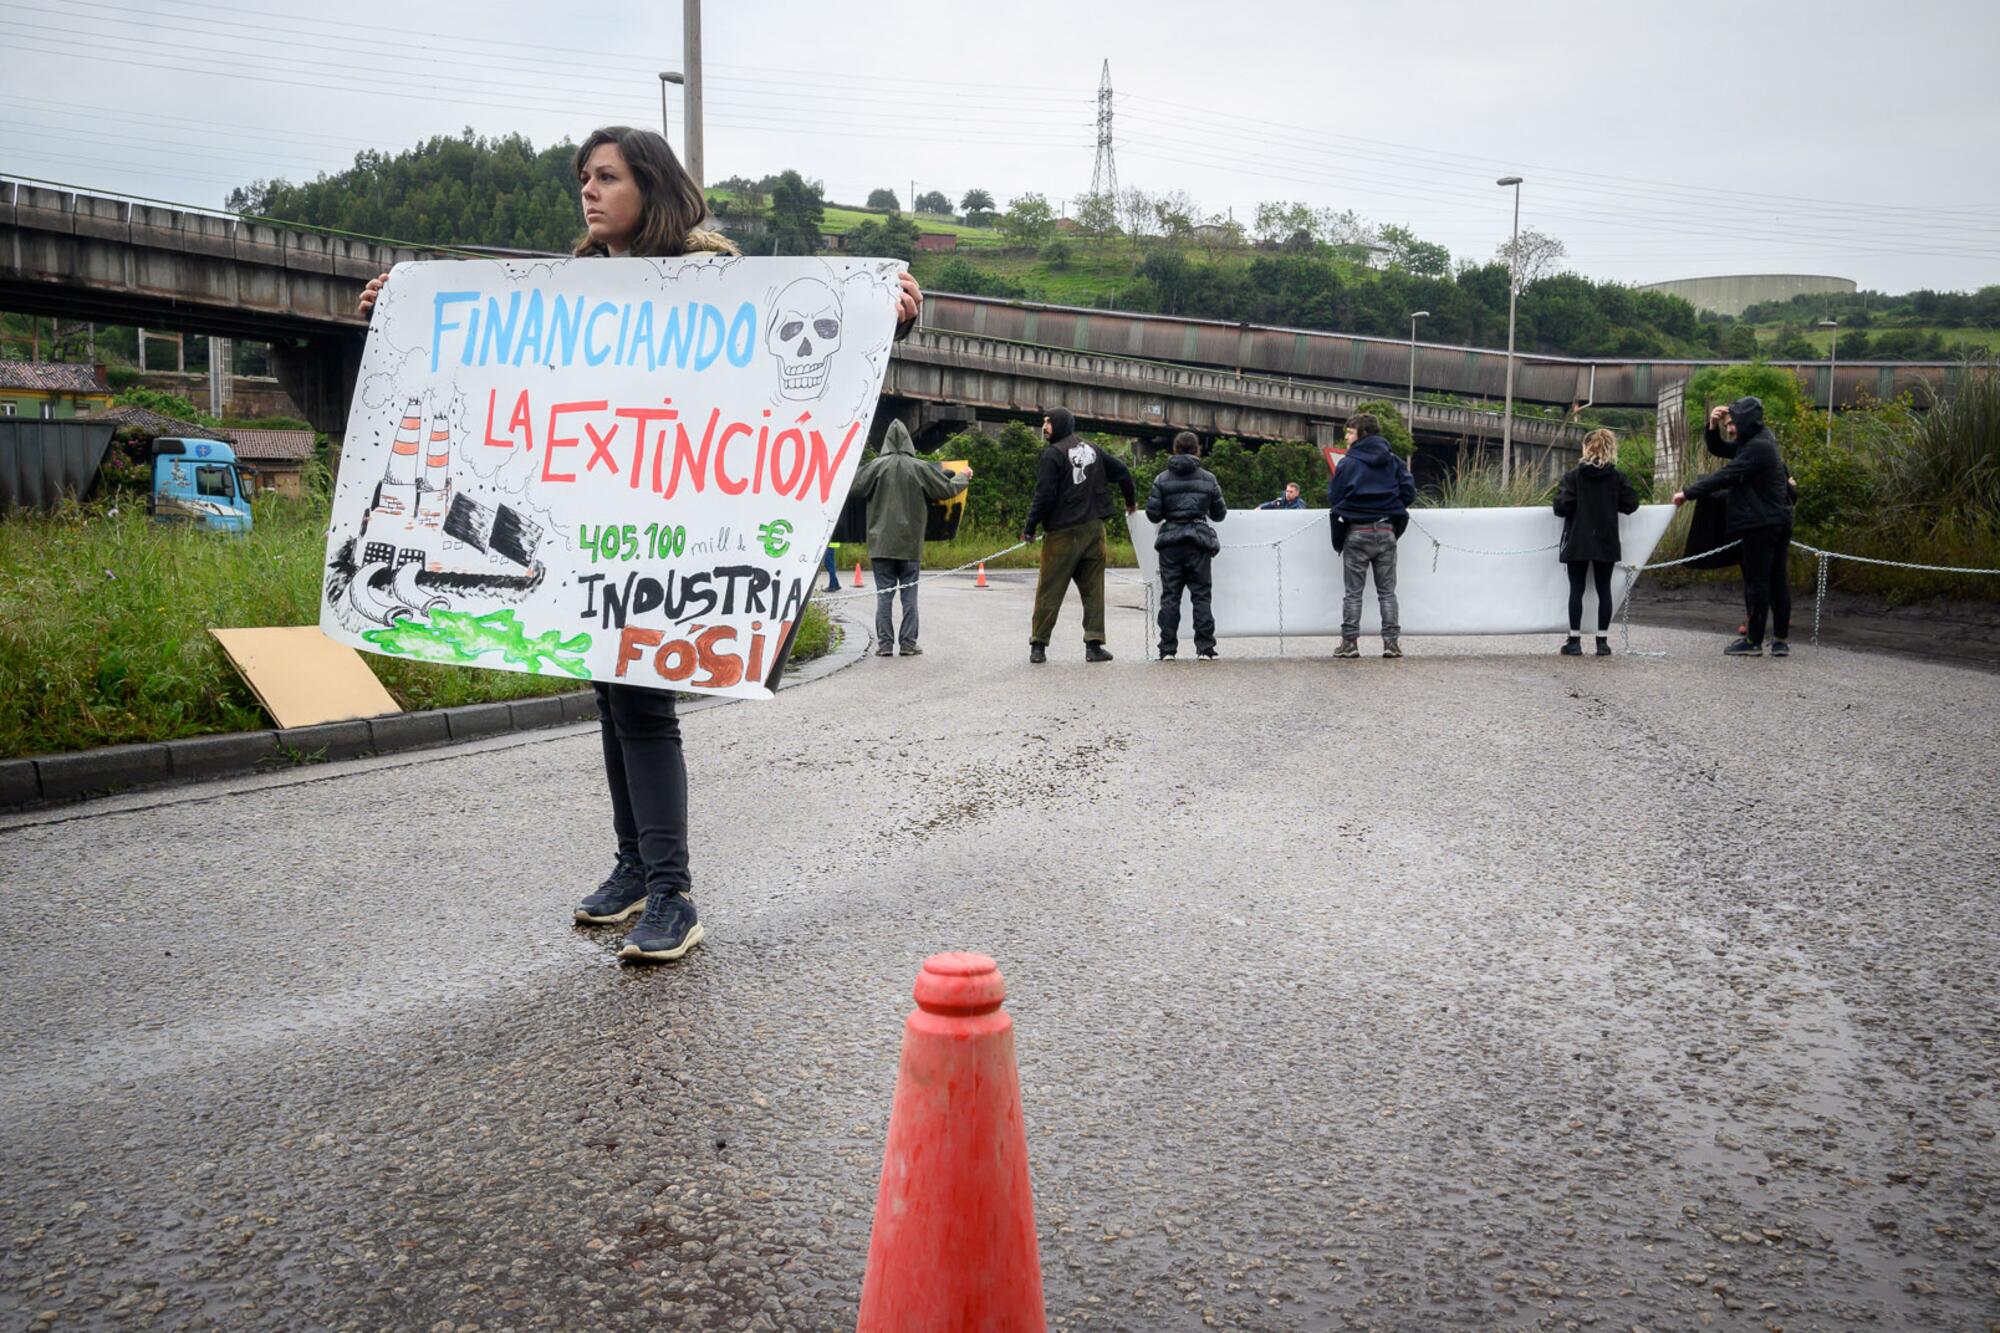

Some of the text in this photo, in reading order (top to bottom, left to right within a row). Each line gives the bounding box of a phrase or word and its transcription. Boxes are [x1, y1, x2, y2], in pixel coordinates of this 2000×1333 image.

[484, 389, 534, 452] LA
[579, 522, 686, 563] 405.100
[756, 519, 794, 558] €
